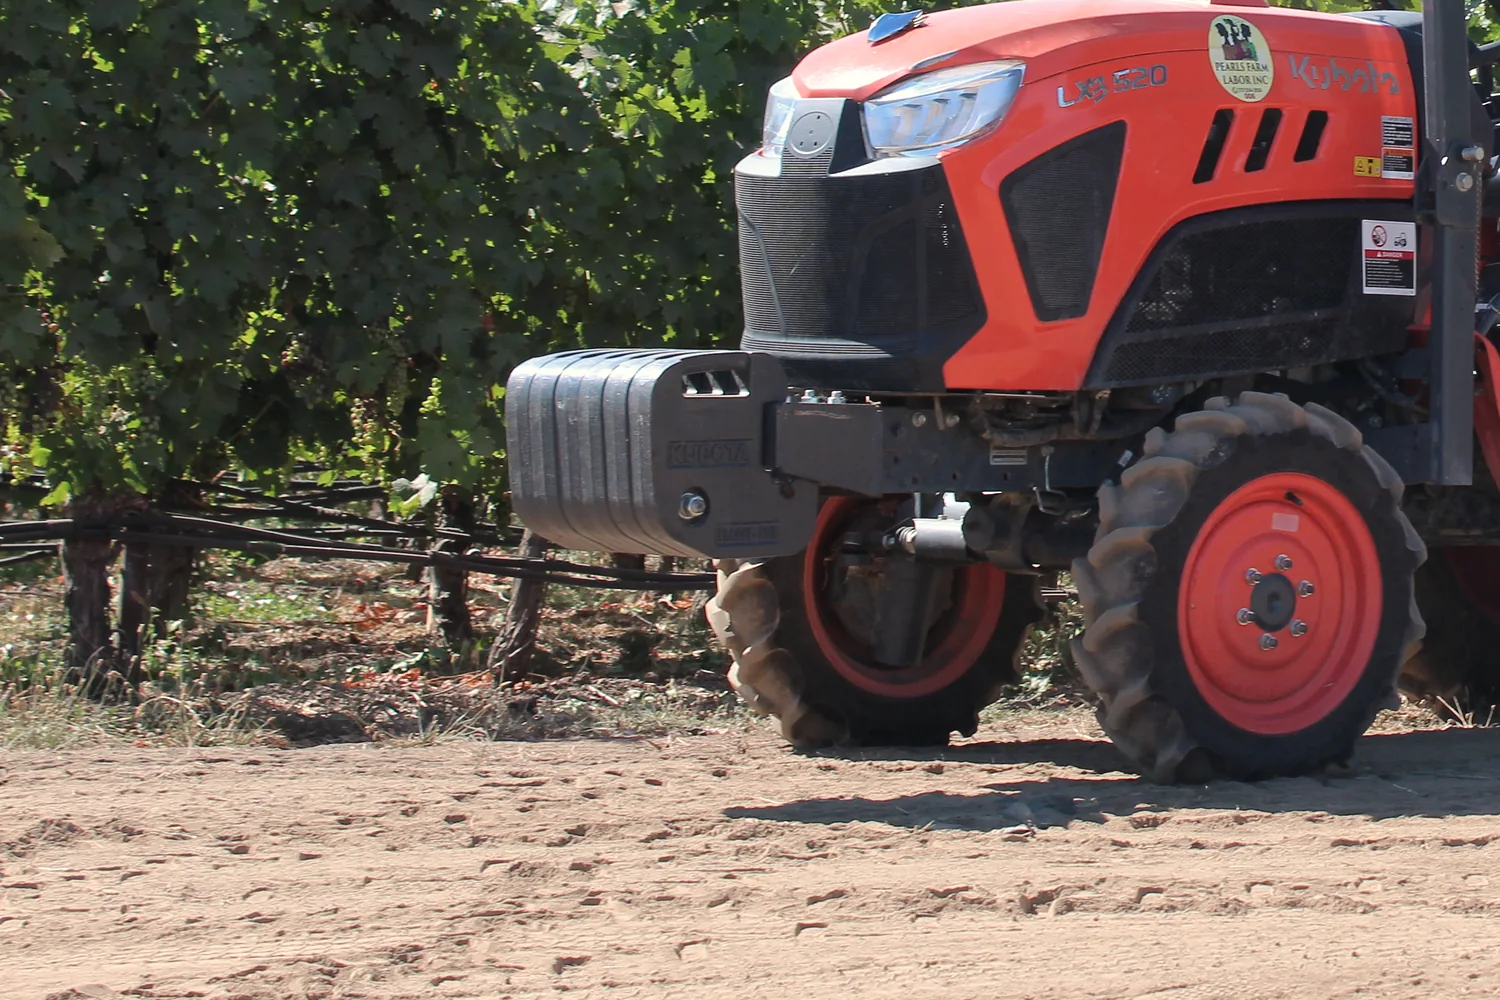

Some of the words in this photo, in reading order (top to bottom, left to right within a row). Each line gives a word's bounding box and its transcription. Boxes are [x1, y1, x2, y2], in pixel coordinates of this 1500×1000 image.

[1215, 62, 1246, 71] PEARLS
[1247, 62, 1269, 72] FARM
[1287, 53, 1401, 96] Kubota
[1223, 75, 1252, 85] LABOR
[1253, 75, 1269, 85] INC
[668, 443, 750, 464] KUBOTA
